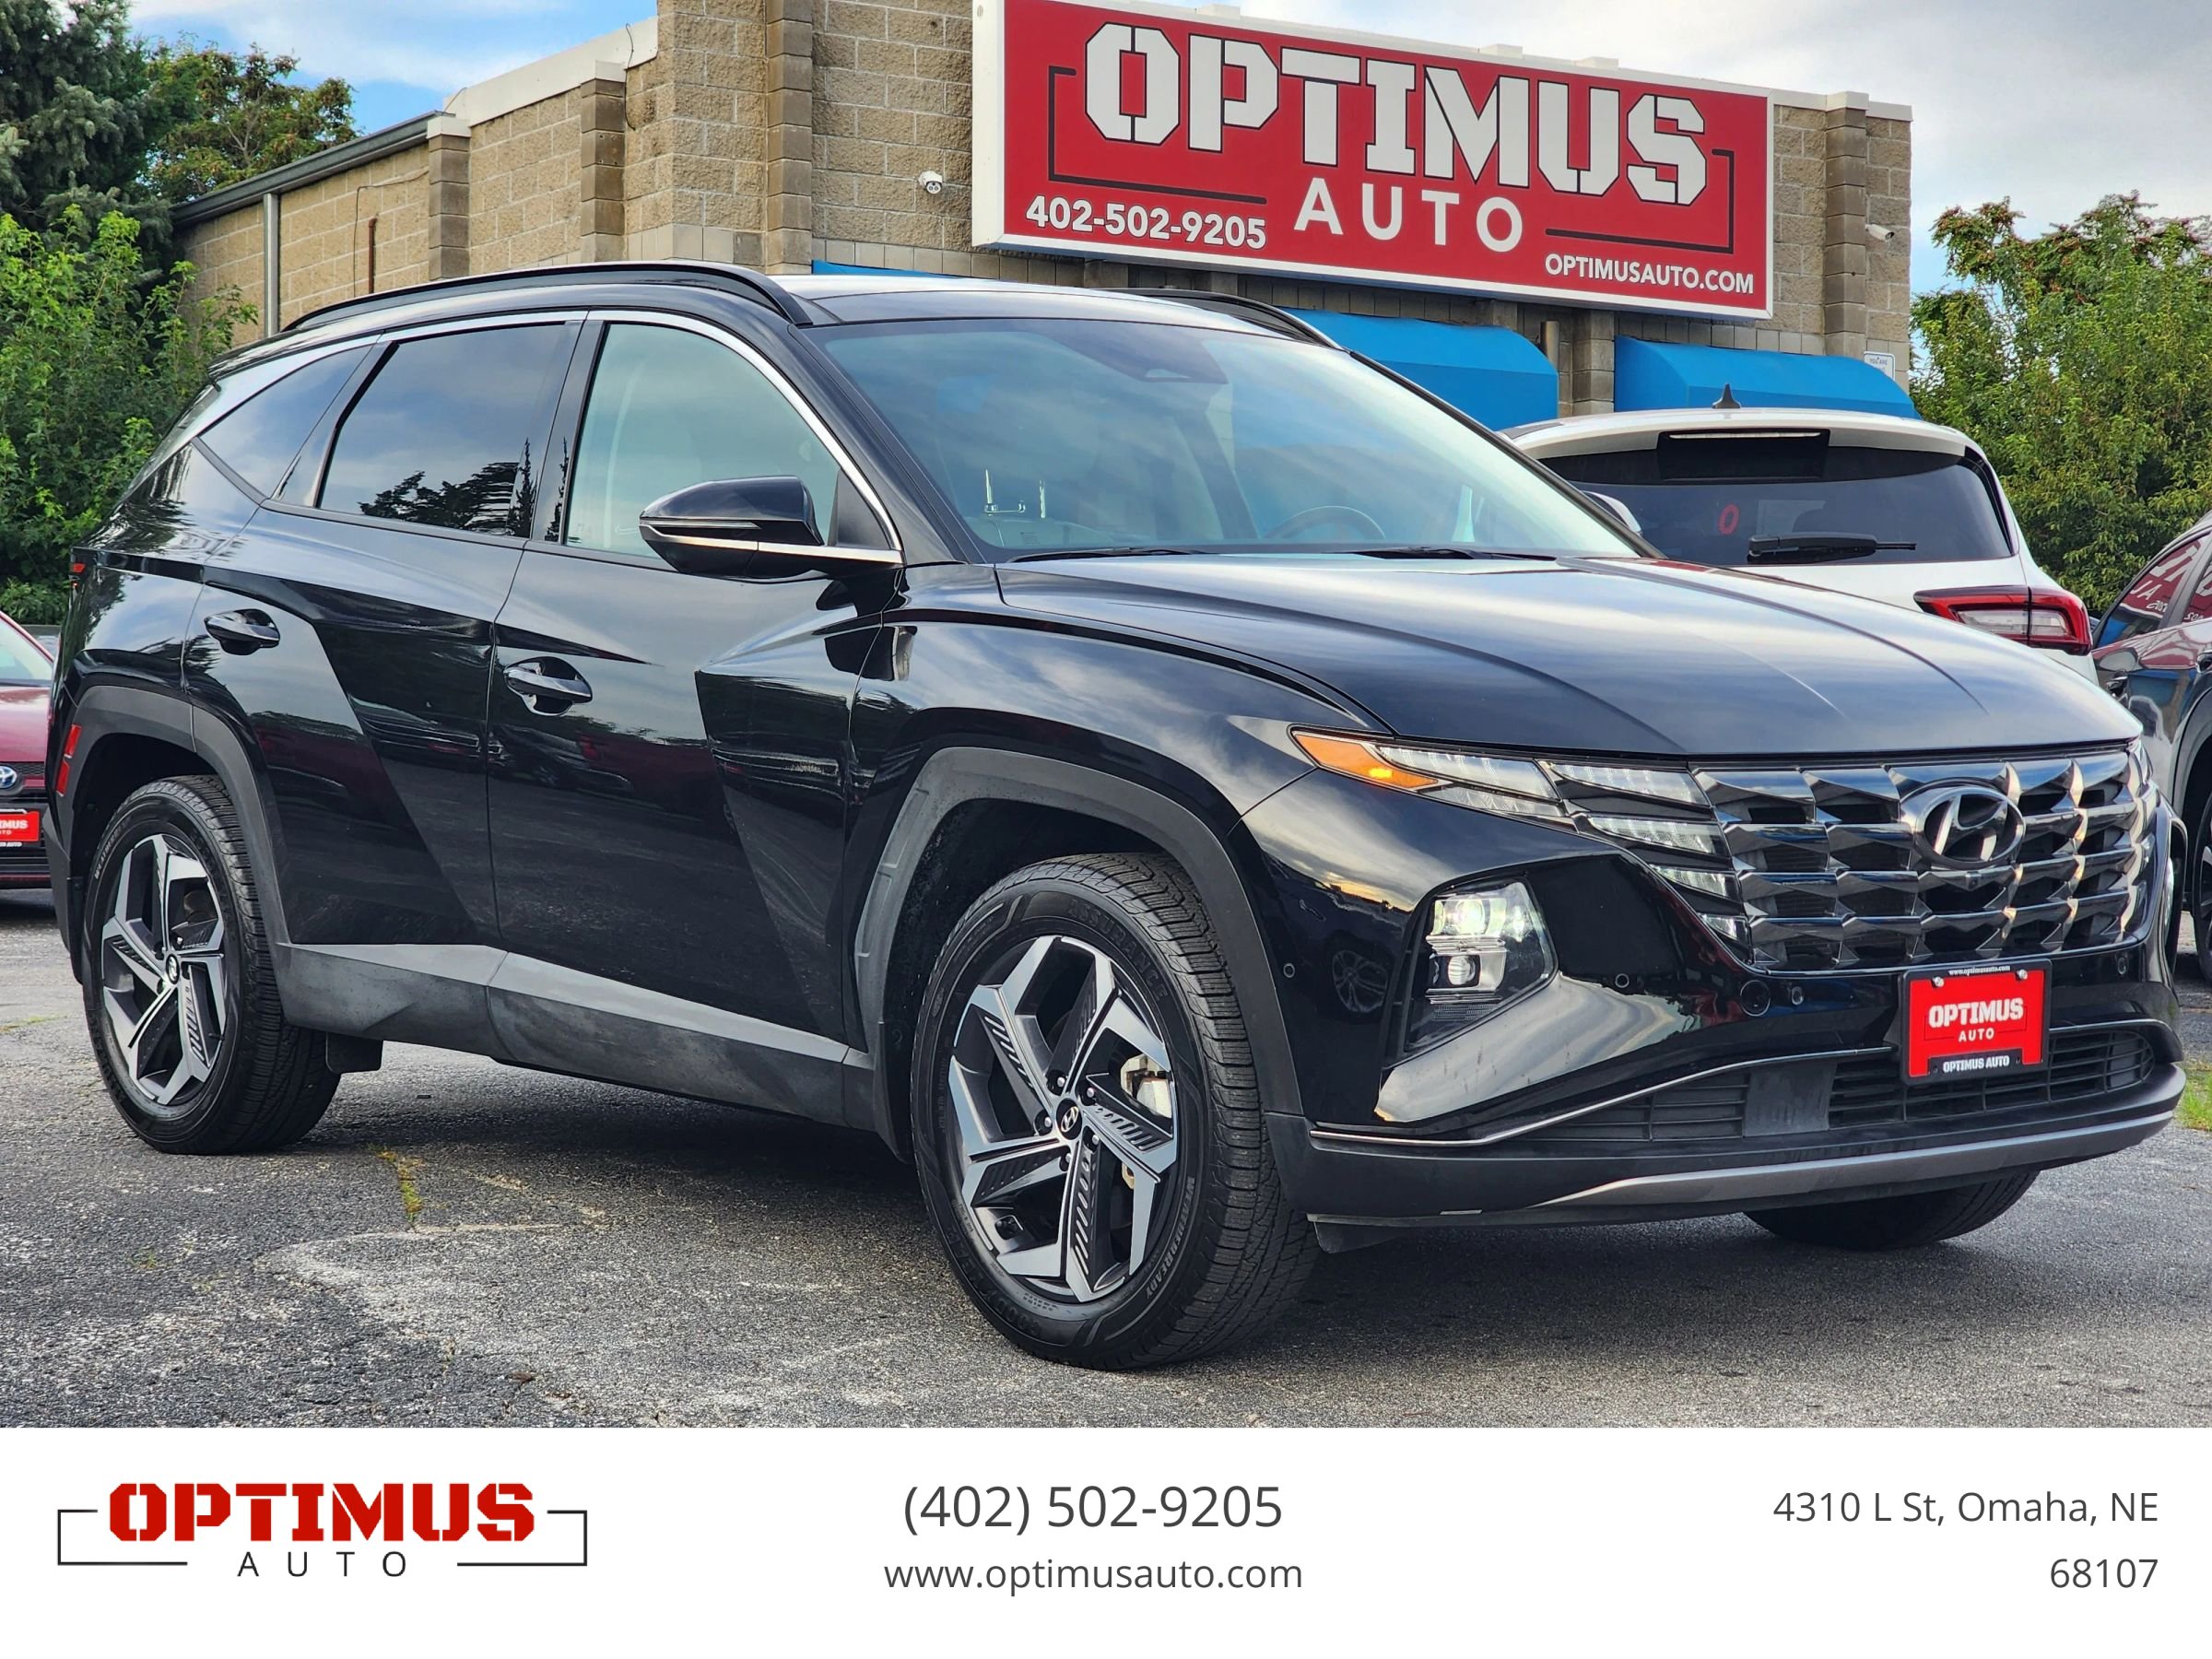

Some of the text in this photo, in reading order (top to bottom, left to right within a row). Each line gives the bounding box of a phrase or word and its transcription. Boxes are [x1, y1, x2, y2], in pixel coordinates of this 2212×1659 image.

[1085, 23, 1707, 206] OPTIMUS
[1026, 195, 1267, 250] 402-502-9205
[1294, 178, 1524, 253] AUTO
[1545, 253, 1754, 294] OPTIMUSAUTO.COM
[1066, 898, 1169, 1002] ASSURANCE
[1948, 965, 2011, 976] www.optimusauto.com
[1928, 997, 2024, 1028] OPTIMUS
[1959, 1028, 1994, 1042] AUTO
[1943, 1055, 2010, 1073] OPTIMUS AUTO
[1147, 1176, 1195, 1299] WEATHERREADY
